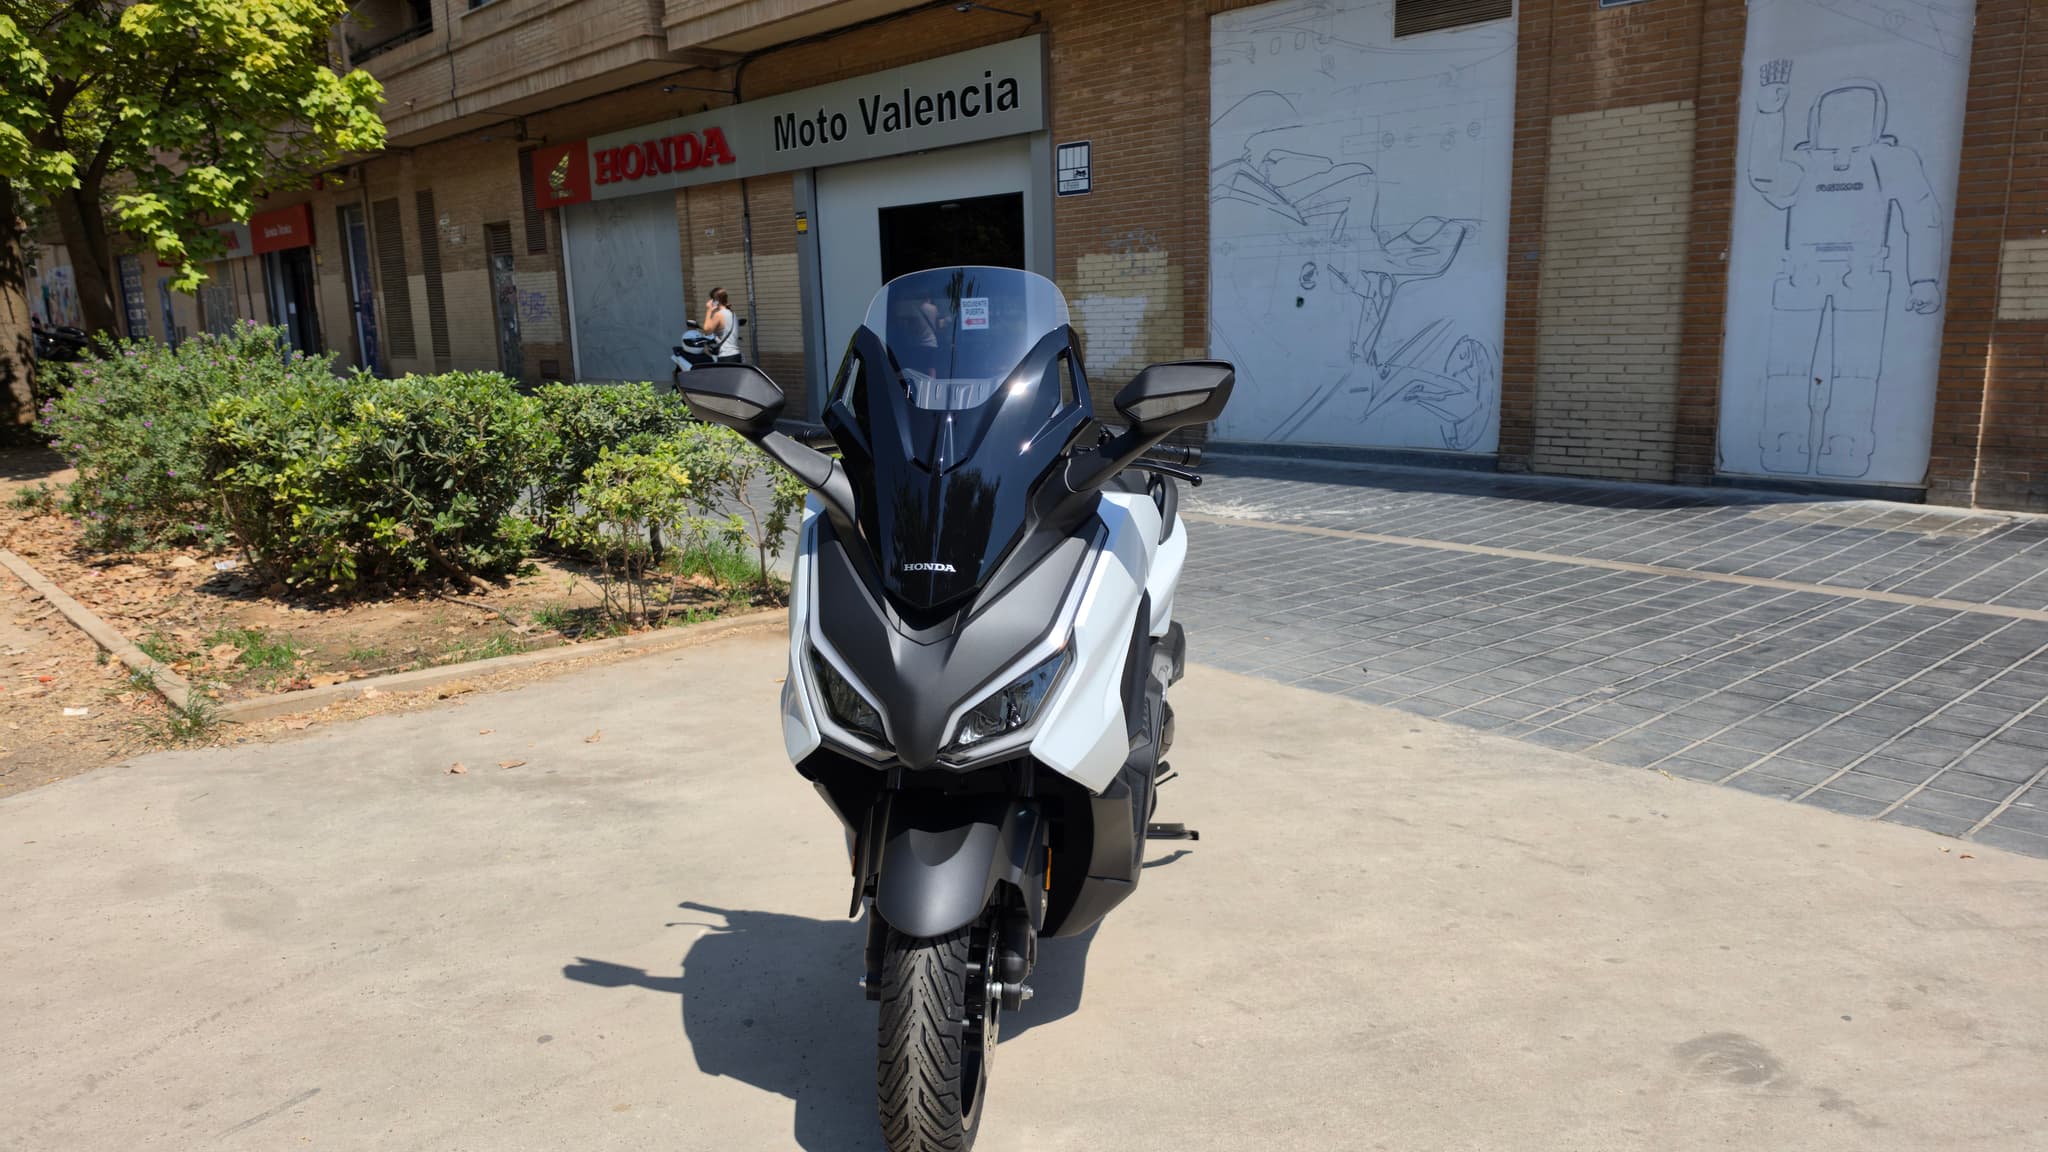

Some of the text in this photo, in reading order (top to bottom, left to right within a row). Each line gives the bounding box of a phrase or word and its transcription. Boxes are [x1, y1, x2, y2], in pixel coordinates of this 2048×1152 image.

[774, 70, 1019, 151] Moto Valencia
[593, 127, 737, 186] HONDA
[965, 308, 985, 316] PUERTA
[903, 562, 957, 573] HONDA
